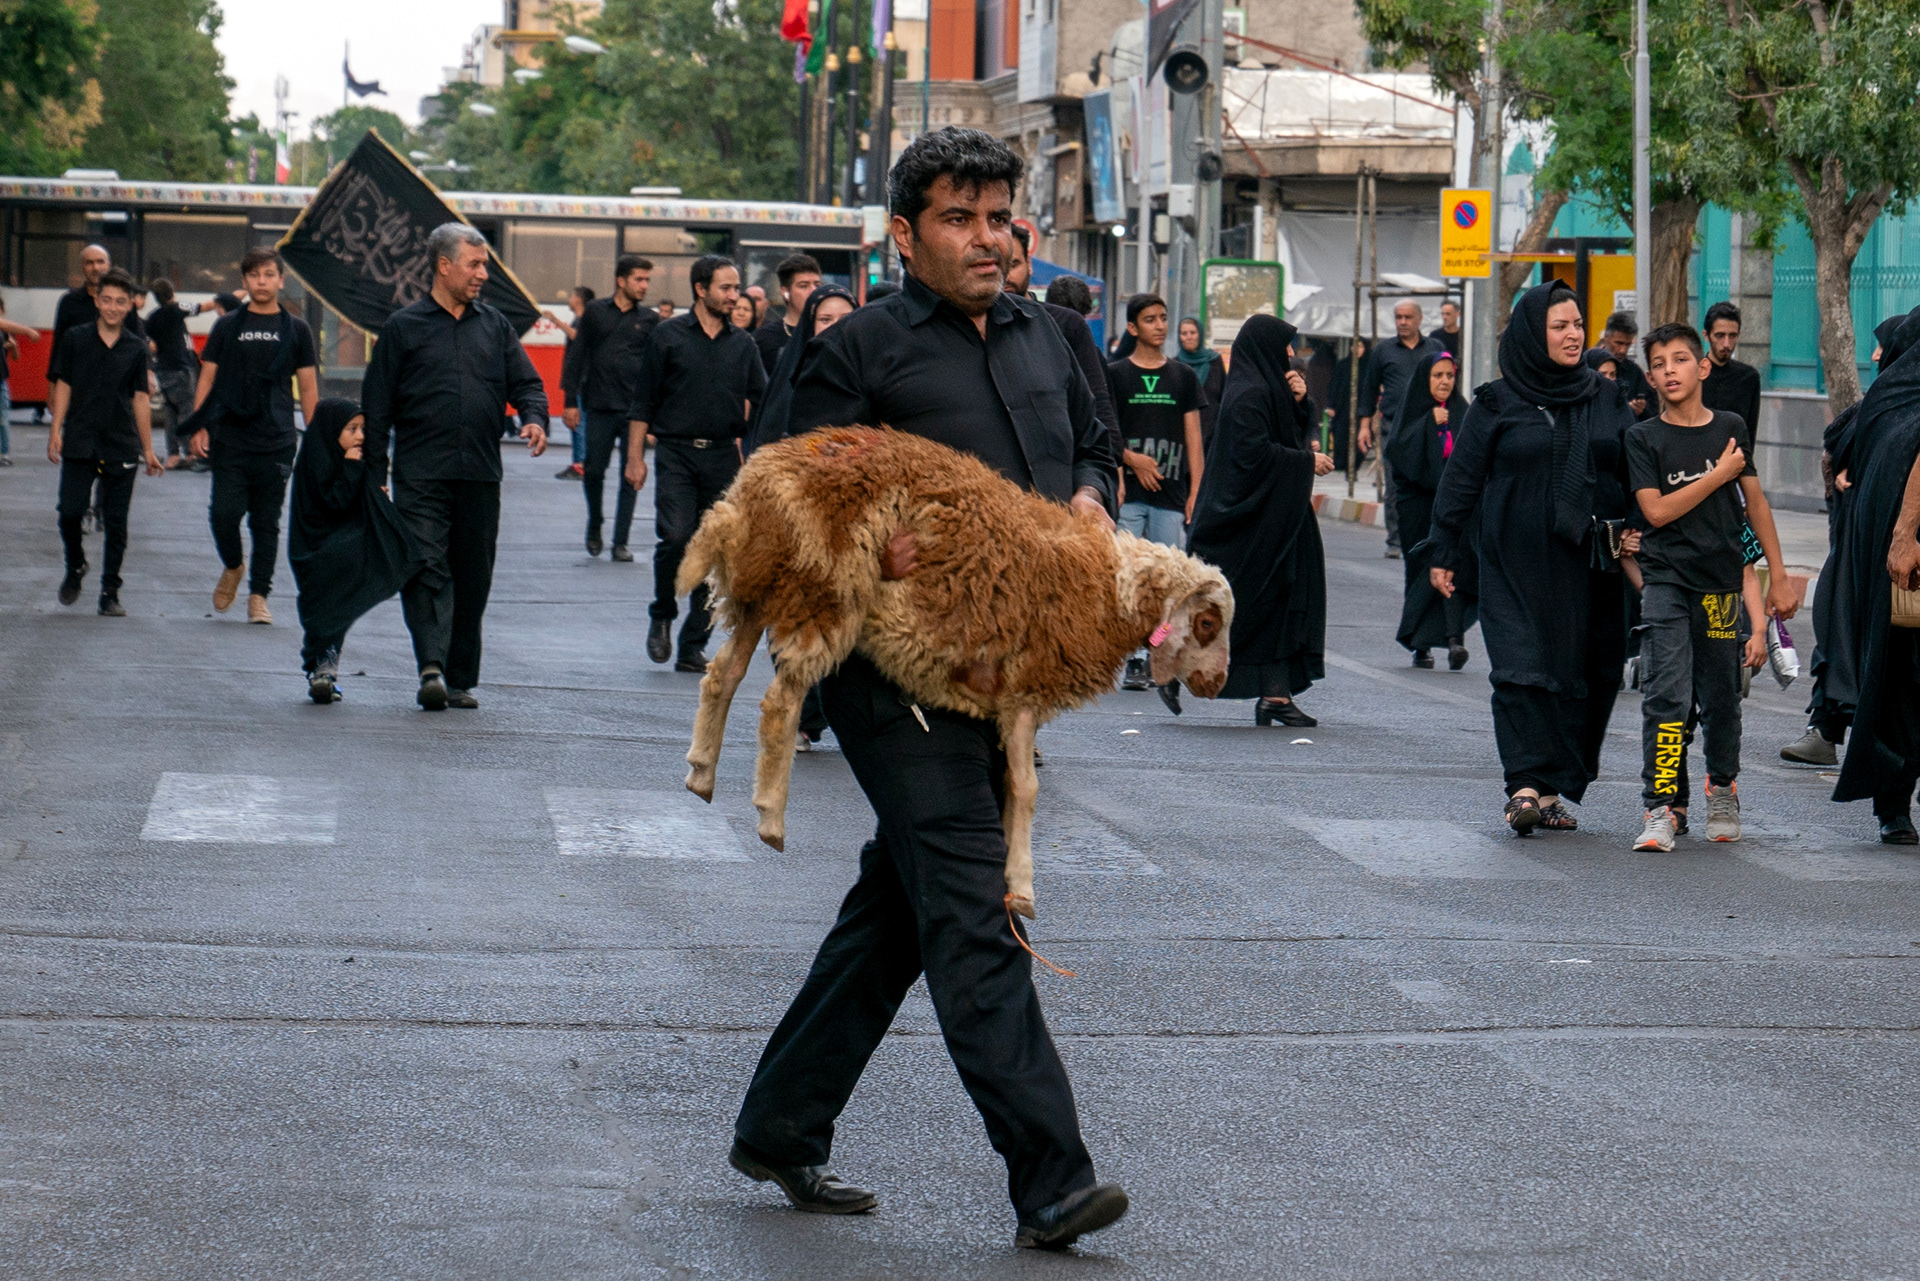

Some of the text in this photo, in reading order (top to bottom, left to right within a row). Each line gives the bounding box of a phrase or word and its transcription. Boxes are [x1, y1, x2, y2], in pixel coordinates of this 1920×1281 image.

[1445, 259, 1486, 267] BUS STOP
[1141, 375, 1160, 393] V
[1706, 630, 1736, 639] VERSACE
[1654, 722, 1683, 795] VERSACE
